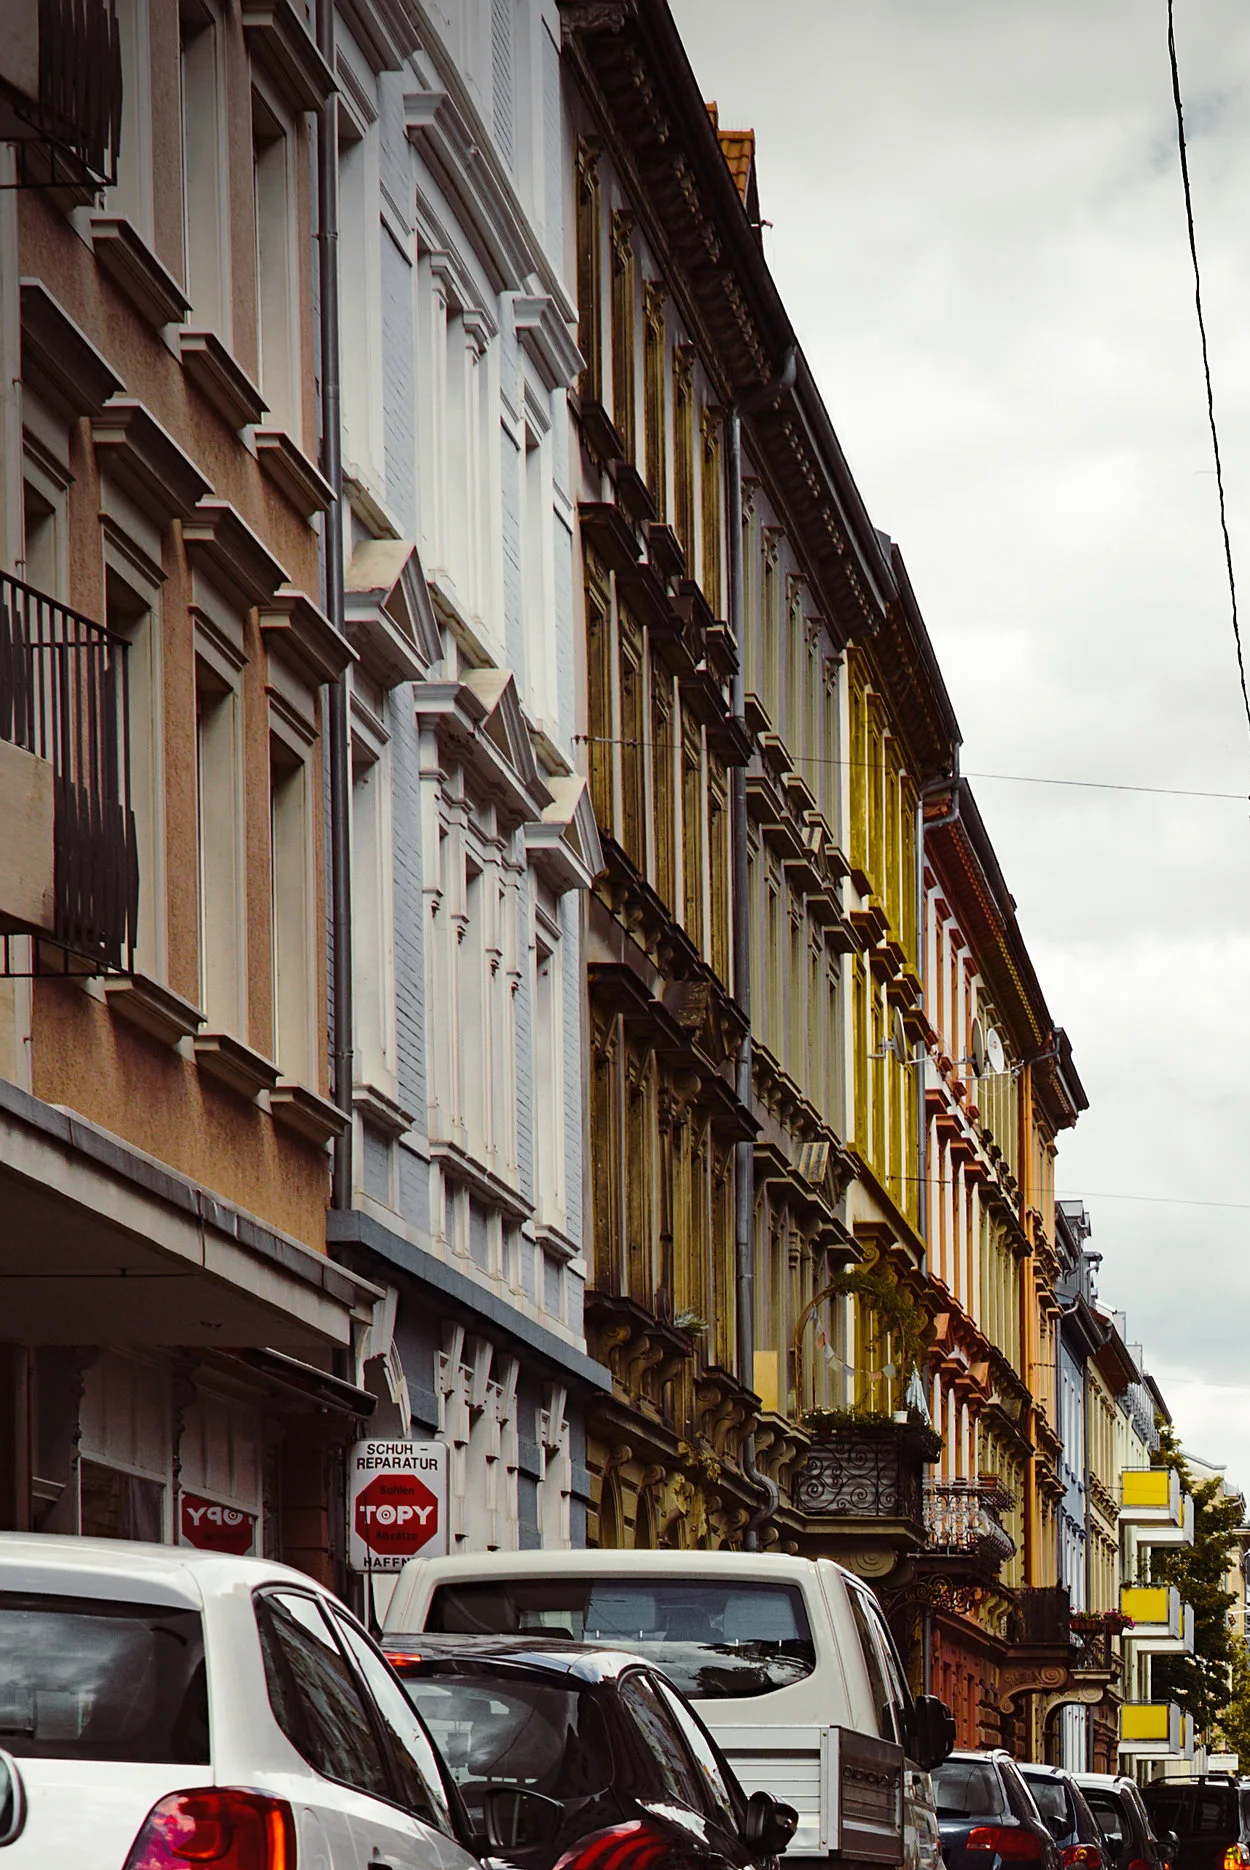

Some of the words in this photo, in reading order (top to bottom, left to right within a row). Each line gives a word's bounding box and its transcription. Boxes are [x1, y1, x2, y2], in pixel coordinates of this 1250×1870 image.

[366, 1443, 413, 1455] SCHUH
[356, 1457, 438, 1470] REPARATUR
[380, 1486, 414, 1495] Sohlen
[359, 1504, 434, 1525] TOPY
[363, 1557, 415, 1568] HAFFN
